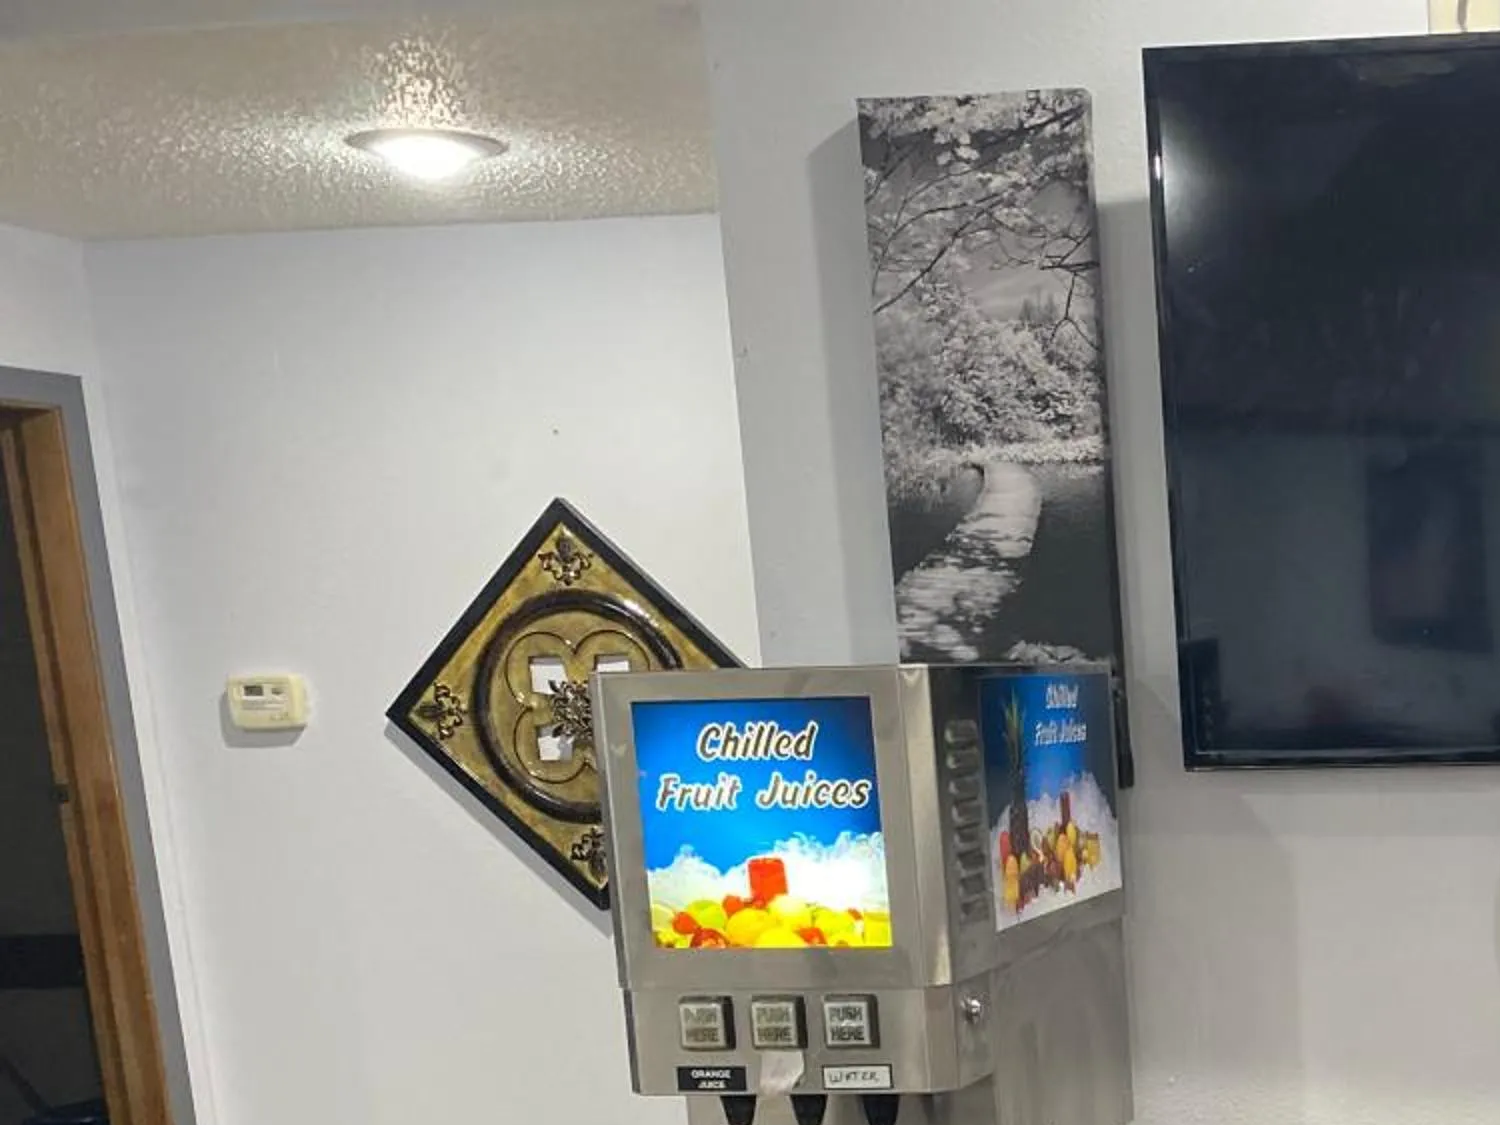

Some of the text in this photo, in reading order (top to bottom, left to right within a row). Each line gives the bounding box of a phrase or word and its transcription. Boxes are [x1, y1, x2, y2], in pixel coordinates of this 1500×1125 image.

[698, 721, 817, 762] Chilled
[656, 769, 872, 811] Fruit Juices
[829, 1006, 863, 1021] PUSH
[757, 1027, 792, 1041] HERE
[830, 1026, 865, 1041] HERE
[691, 1069, 731, 1079] ORANGE
[698, 1080, 727, 1089] JUICE
